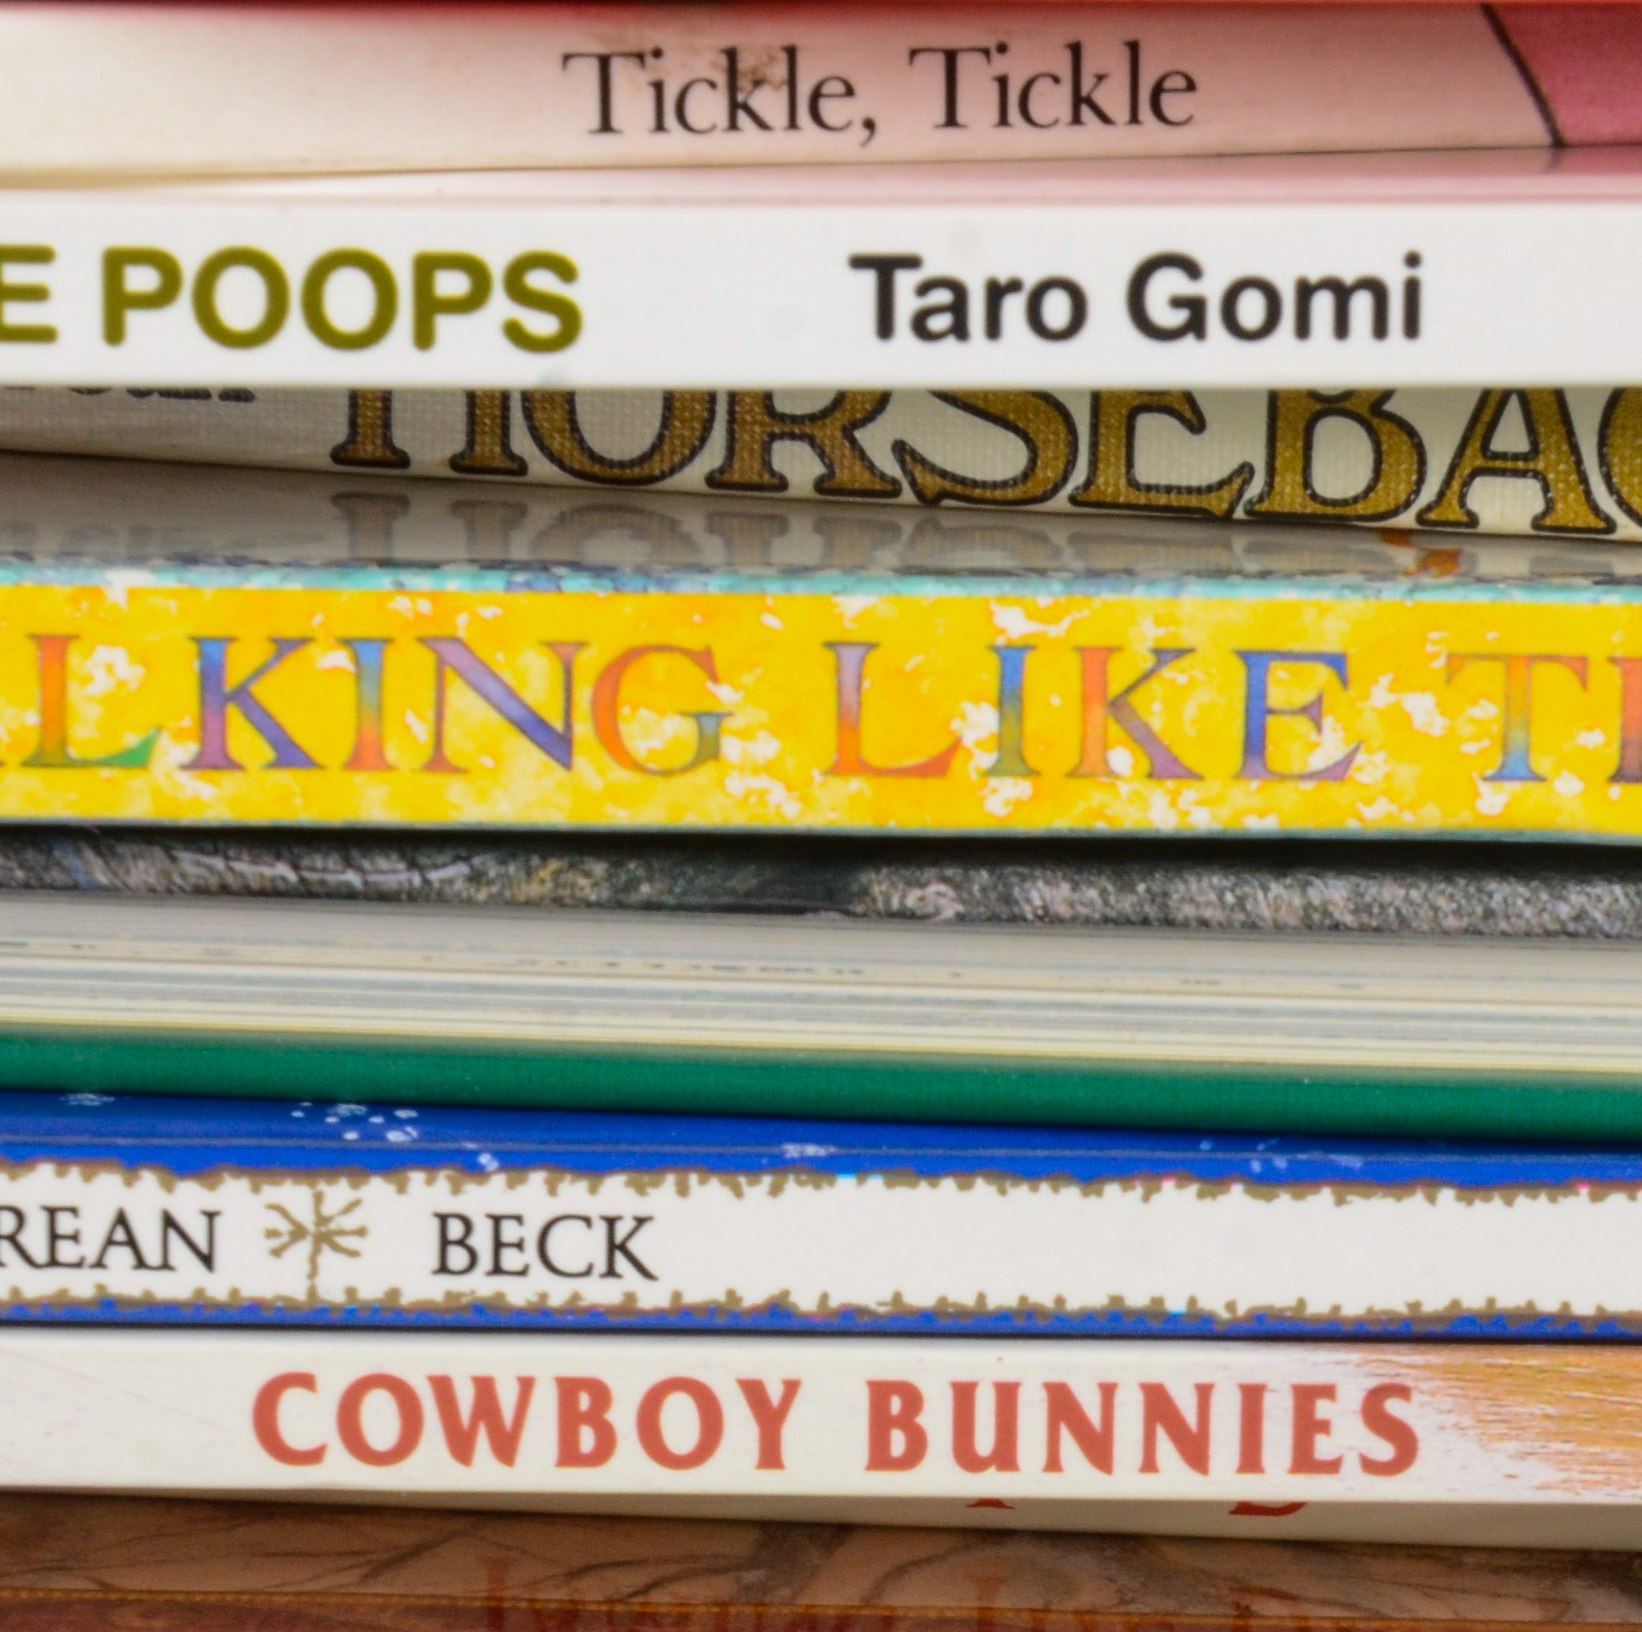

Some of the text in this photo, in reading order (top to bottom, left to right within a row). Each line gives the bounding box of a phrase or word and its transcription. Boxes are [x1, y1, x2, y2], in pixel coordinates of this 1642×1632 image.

[562, 42, 1199, 145] Tickle, Tickle
[101, 245, 584, 354] POOPS
[848, 250, 1422, 344] Taro Gomi
[821, 640, 1360, 787] LIKE
[432, 1213, 658, 1281] BECK
[252, 1371, 1420, 1477] COWBOY BUNNIES
